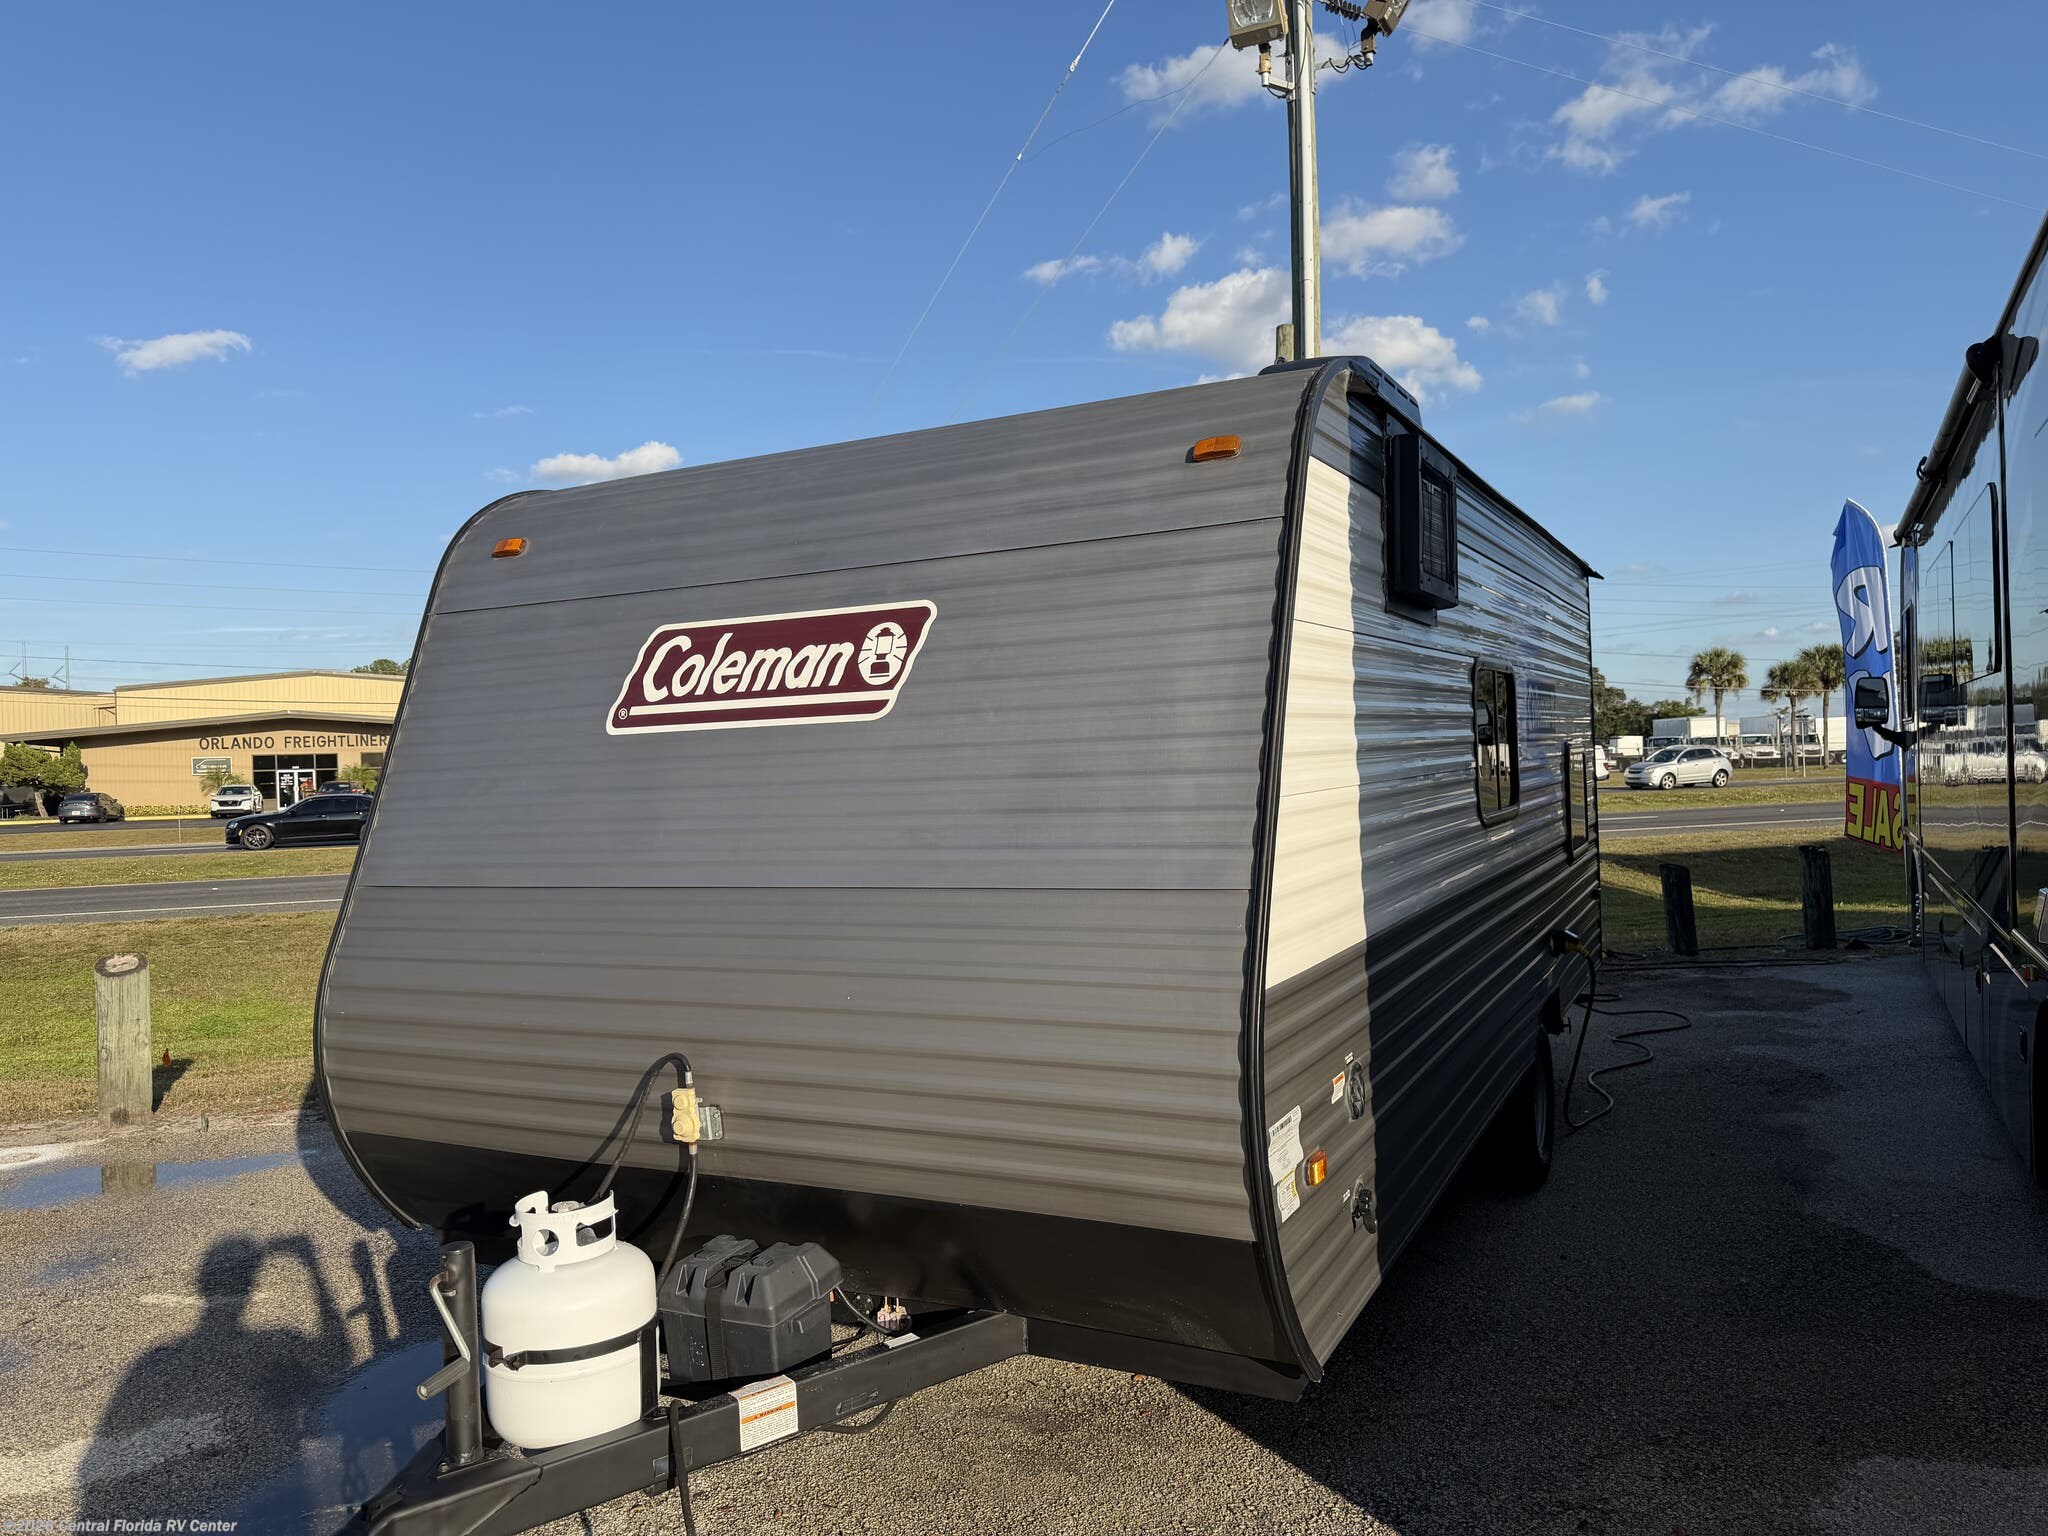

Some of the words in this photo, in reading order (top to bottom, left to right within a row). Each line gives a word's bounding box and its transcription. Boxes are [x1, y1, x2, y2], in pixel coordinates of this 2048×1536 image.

[642, 632, 855, 703] Coleman
[199, 736, 275, 750] ORLANDO
[284, 734, 388, 749] FREIGHTLINER
